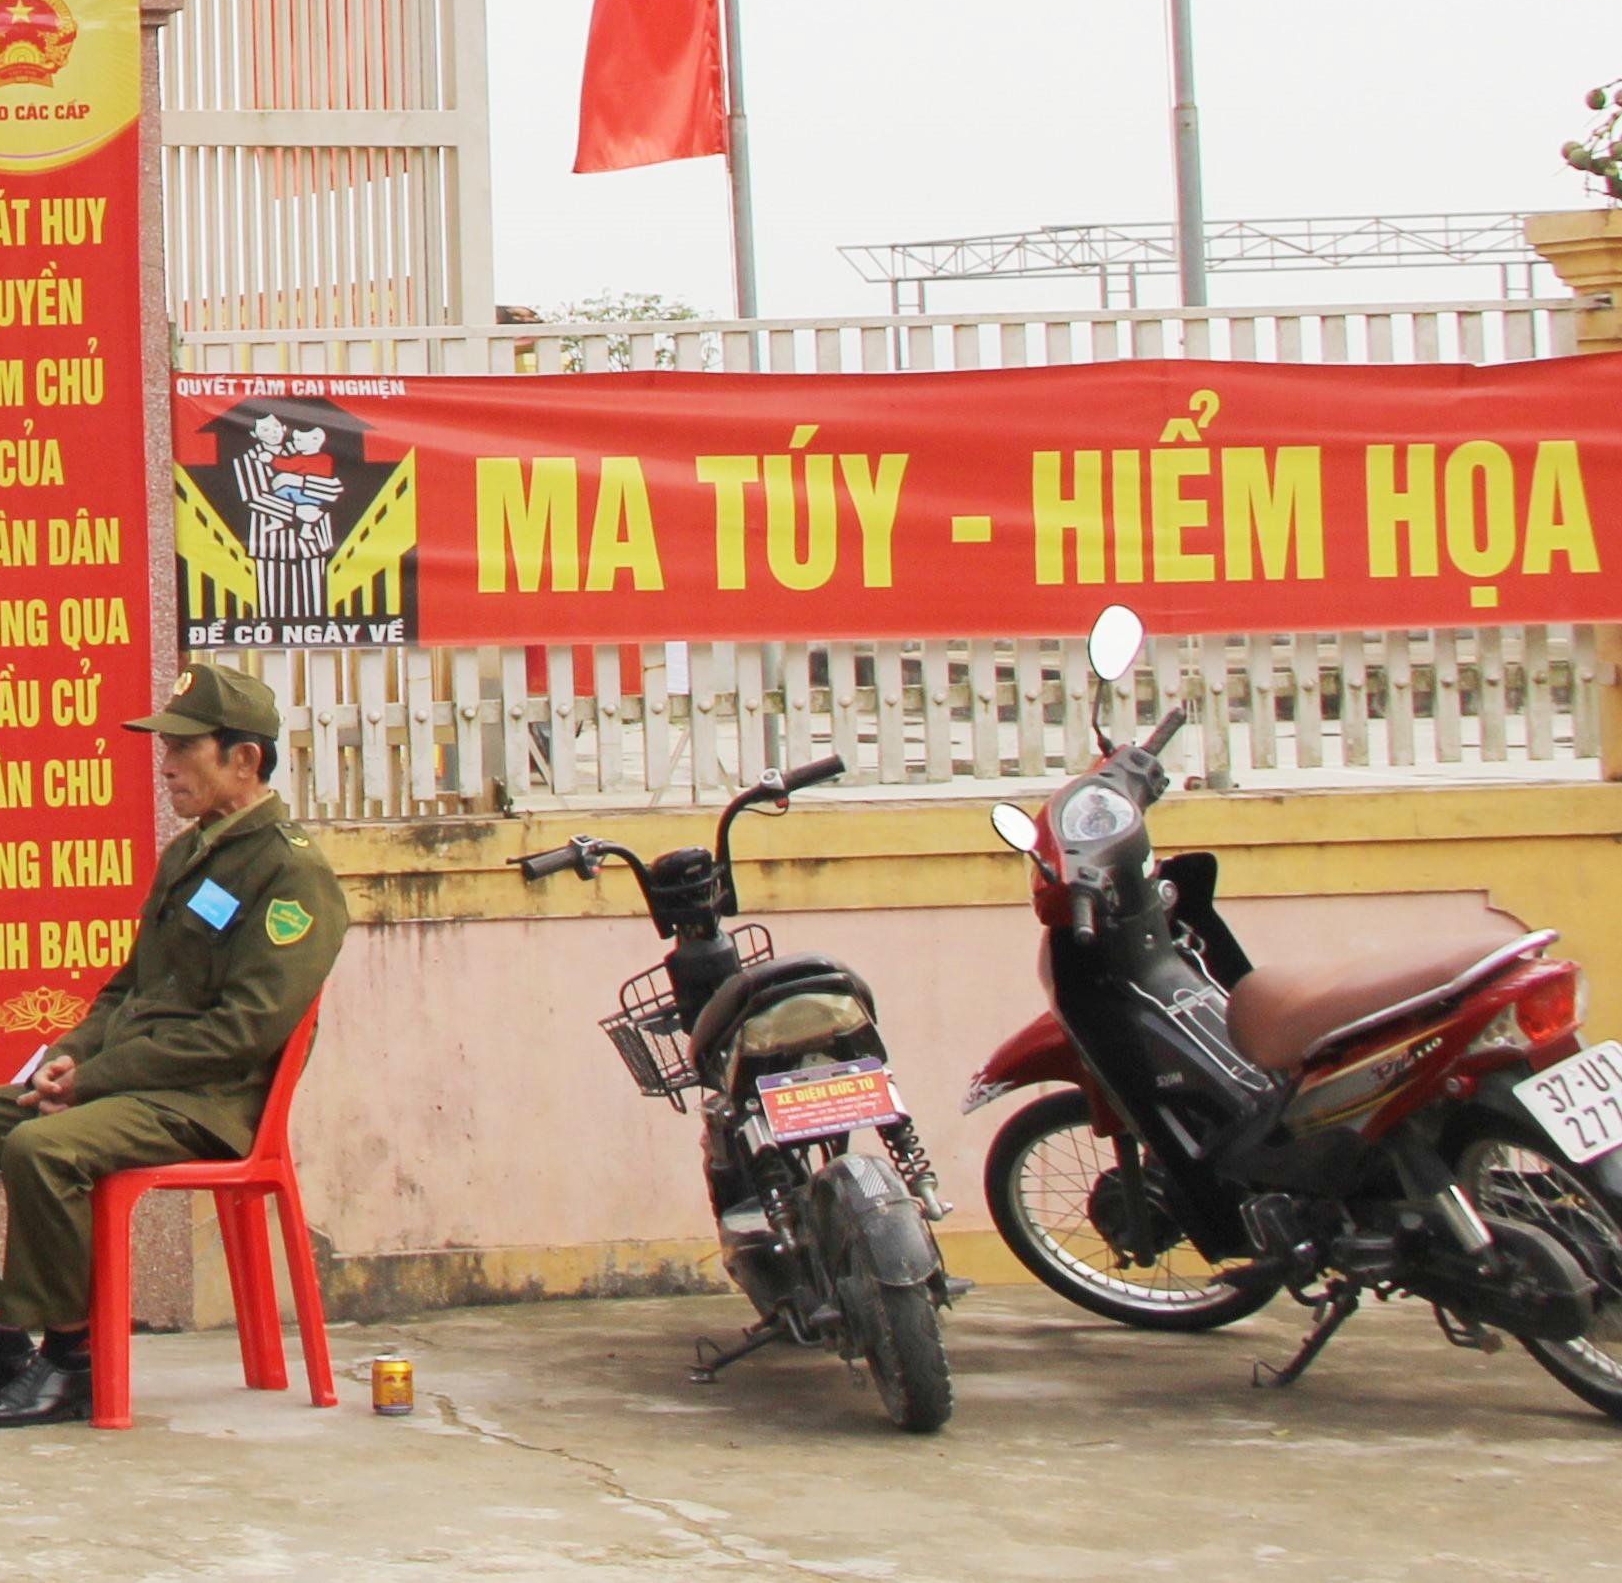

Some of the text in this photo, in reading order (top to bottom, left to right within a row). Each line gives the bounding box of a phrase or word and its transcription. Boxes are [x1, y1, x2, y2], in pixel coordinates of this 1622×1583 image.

[14, 104, 50, 122] CÁC
[53, 102, 91, 121] CẤP
[40, 197, 107, 246] HUY
[35, 336, 104, 407] CHỦ
[175, 374, 407, 400] QUYẾT TÂM CAI NGHIỆN
[475, 389, 1601, 608] MA TÚY - HIỂM HỌA
[48, 507, 120, 566] DÂN
[59, 597, 130, 652] QUA
[233, 619, 273, 646] CÓ
[281, 617, 361, 645] NGÀY
[51, 657, 102, 727] CỬ
[43, 737, 113, 808] CHỦ
[51, 838, 133, 888] KHAI
[775, 1091, 794, 1105] XE
